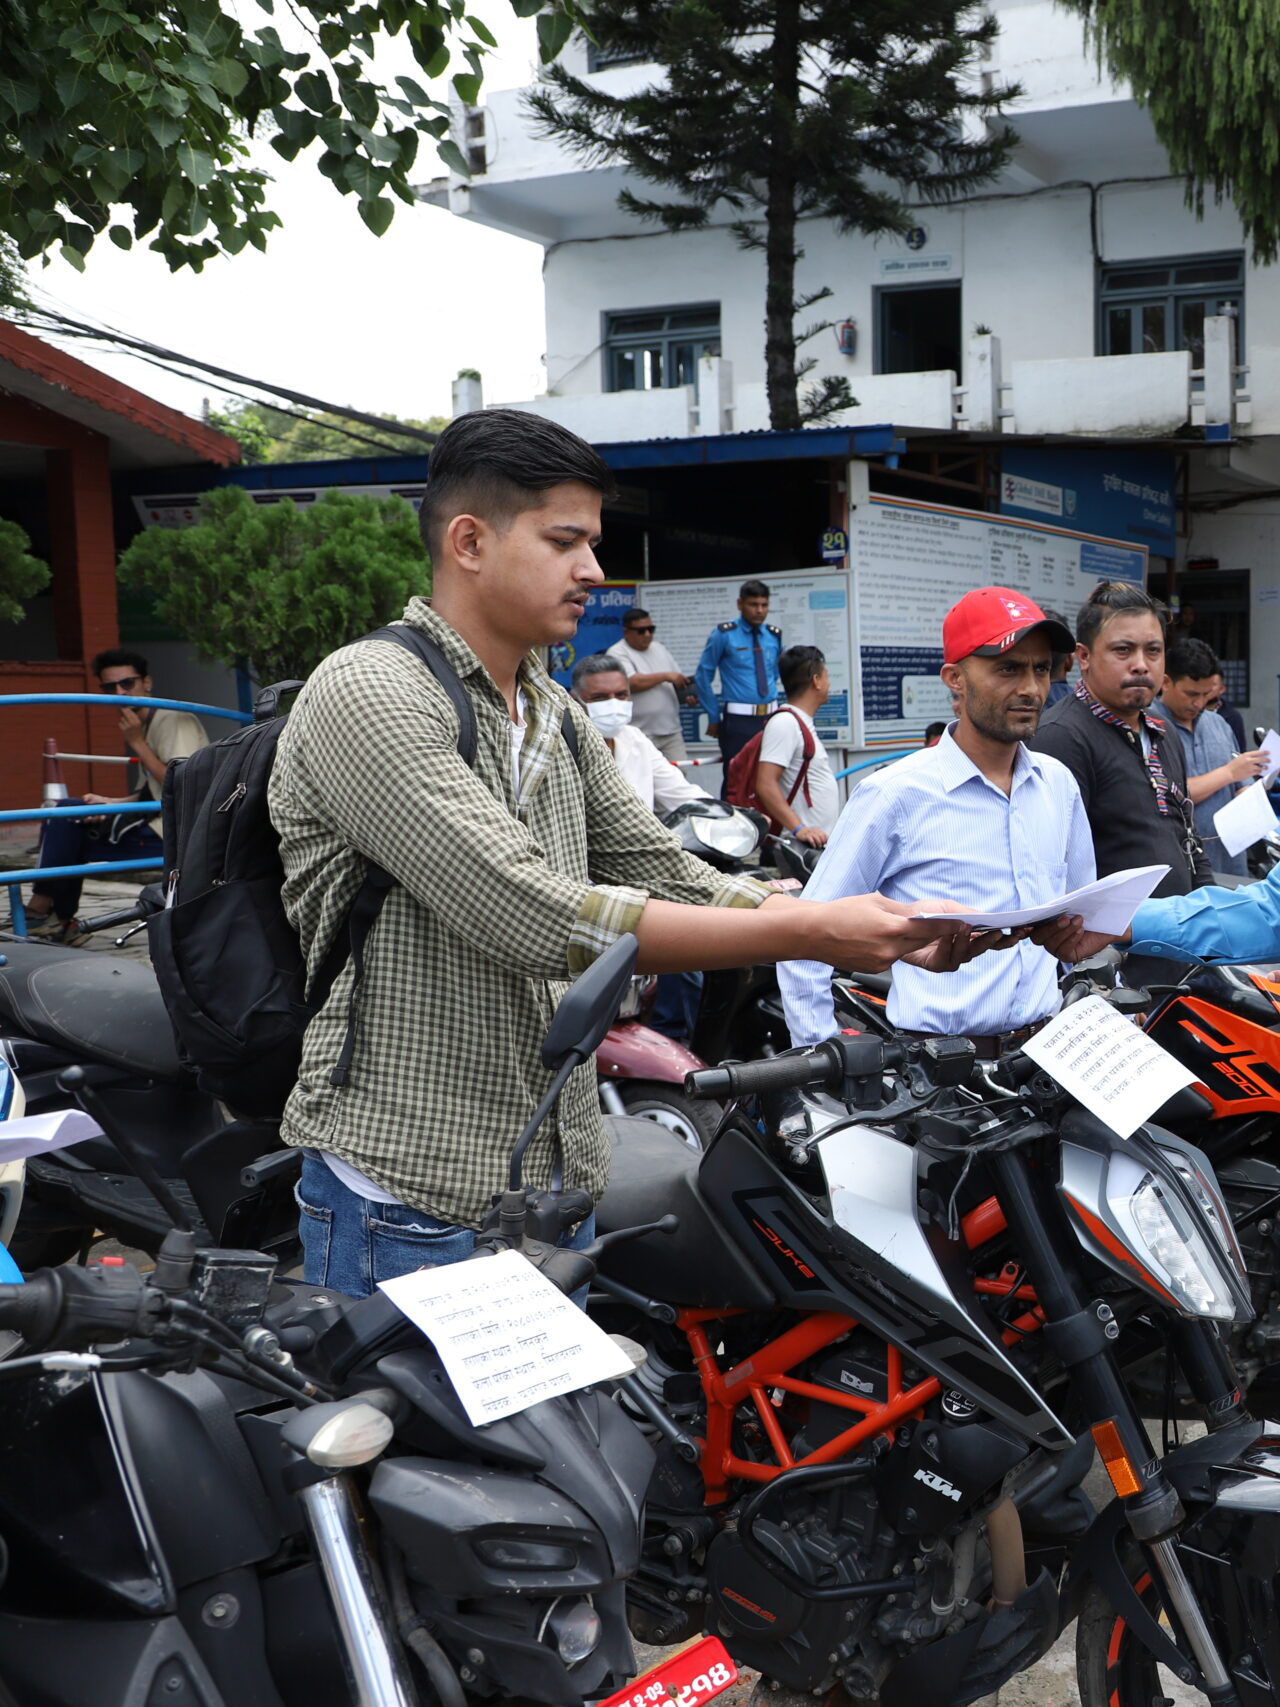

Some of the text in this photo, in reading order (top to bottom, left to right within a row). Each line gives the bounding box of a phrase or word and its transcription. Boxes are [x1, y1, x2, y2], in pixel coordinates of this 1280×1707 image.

[822, 532, 845, 550] २१
[1091, 1034, 1108, 1048] मिति
[1104, 1044, 1121, 1058] स्थान
[1211, 1060, 1263, 1097] 200
[752, 1218, 816, 1279] DUKE
[913, 1468, 963, 1503] KTM
